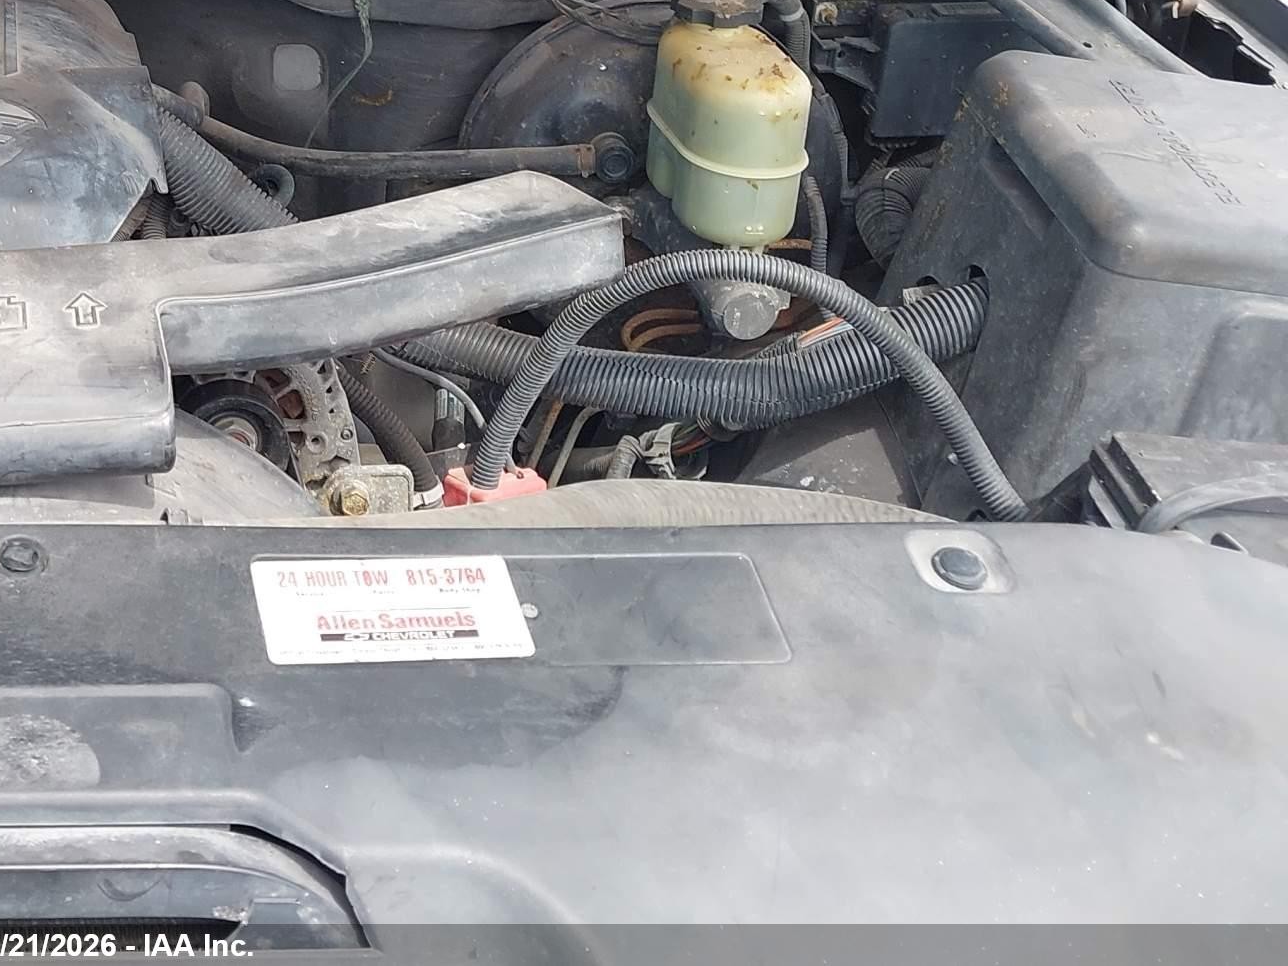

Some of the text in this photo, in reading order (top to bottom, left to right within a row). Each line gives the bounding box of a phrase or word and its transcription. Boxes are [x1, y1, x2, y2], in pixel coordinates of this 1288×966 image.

[277, 567, 487, 588] 24 HOUR TOW 815-3764
[317, 610, 476, 631] Allen Samuels
[372, 630, 456, 642] CHEVROLET
